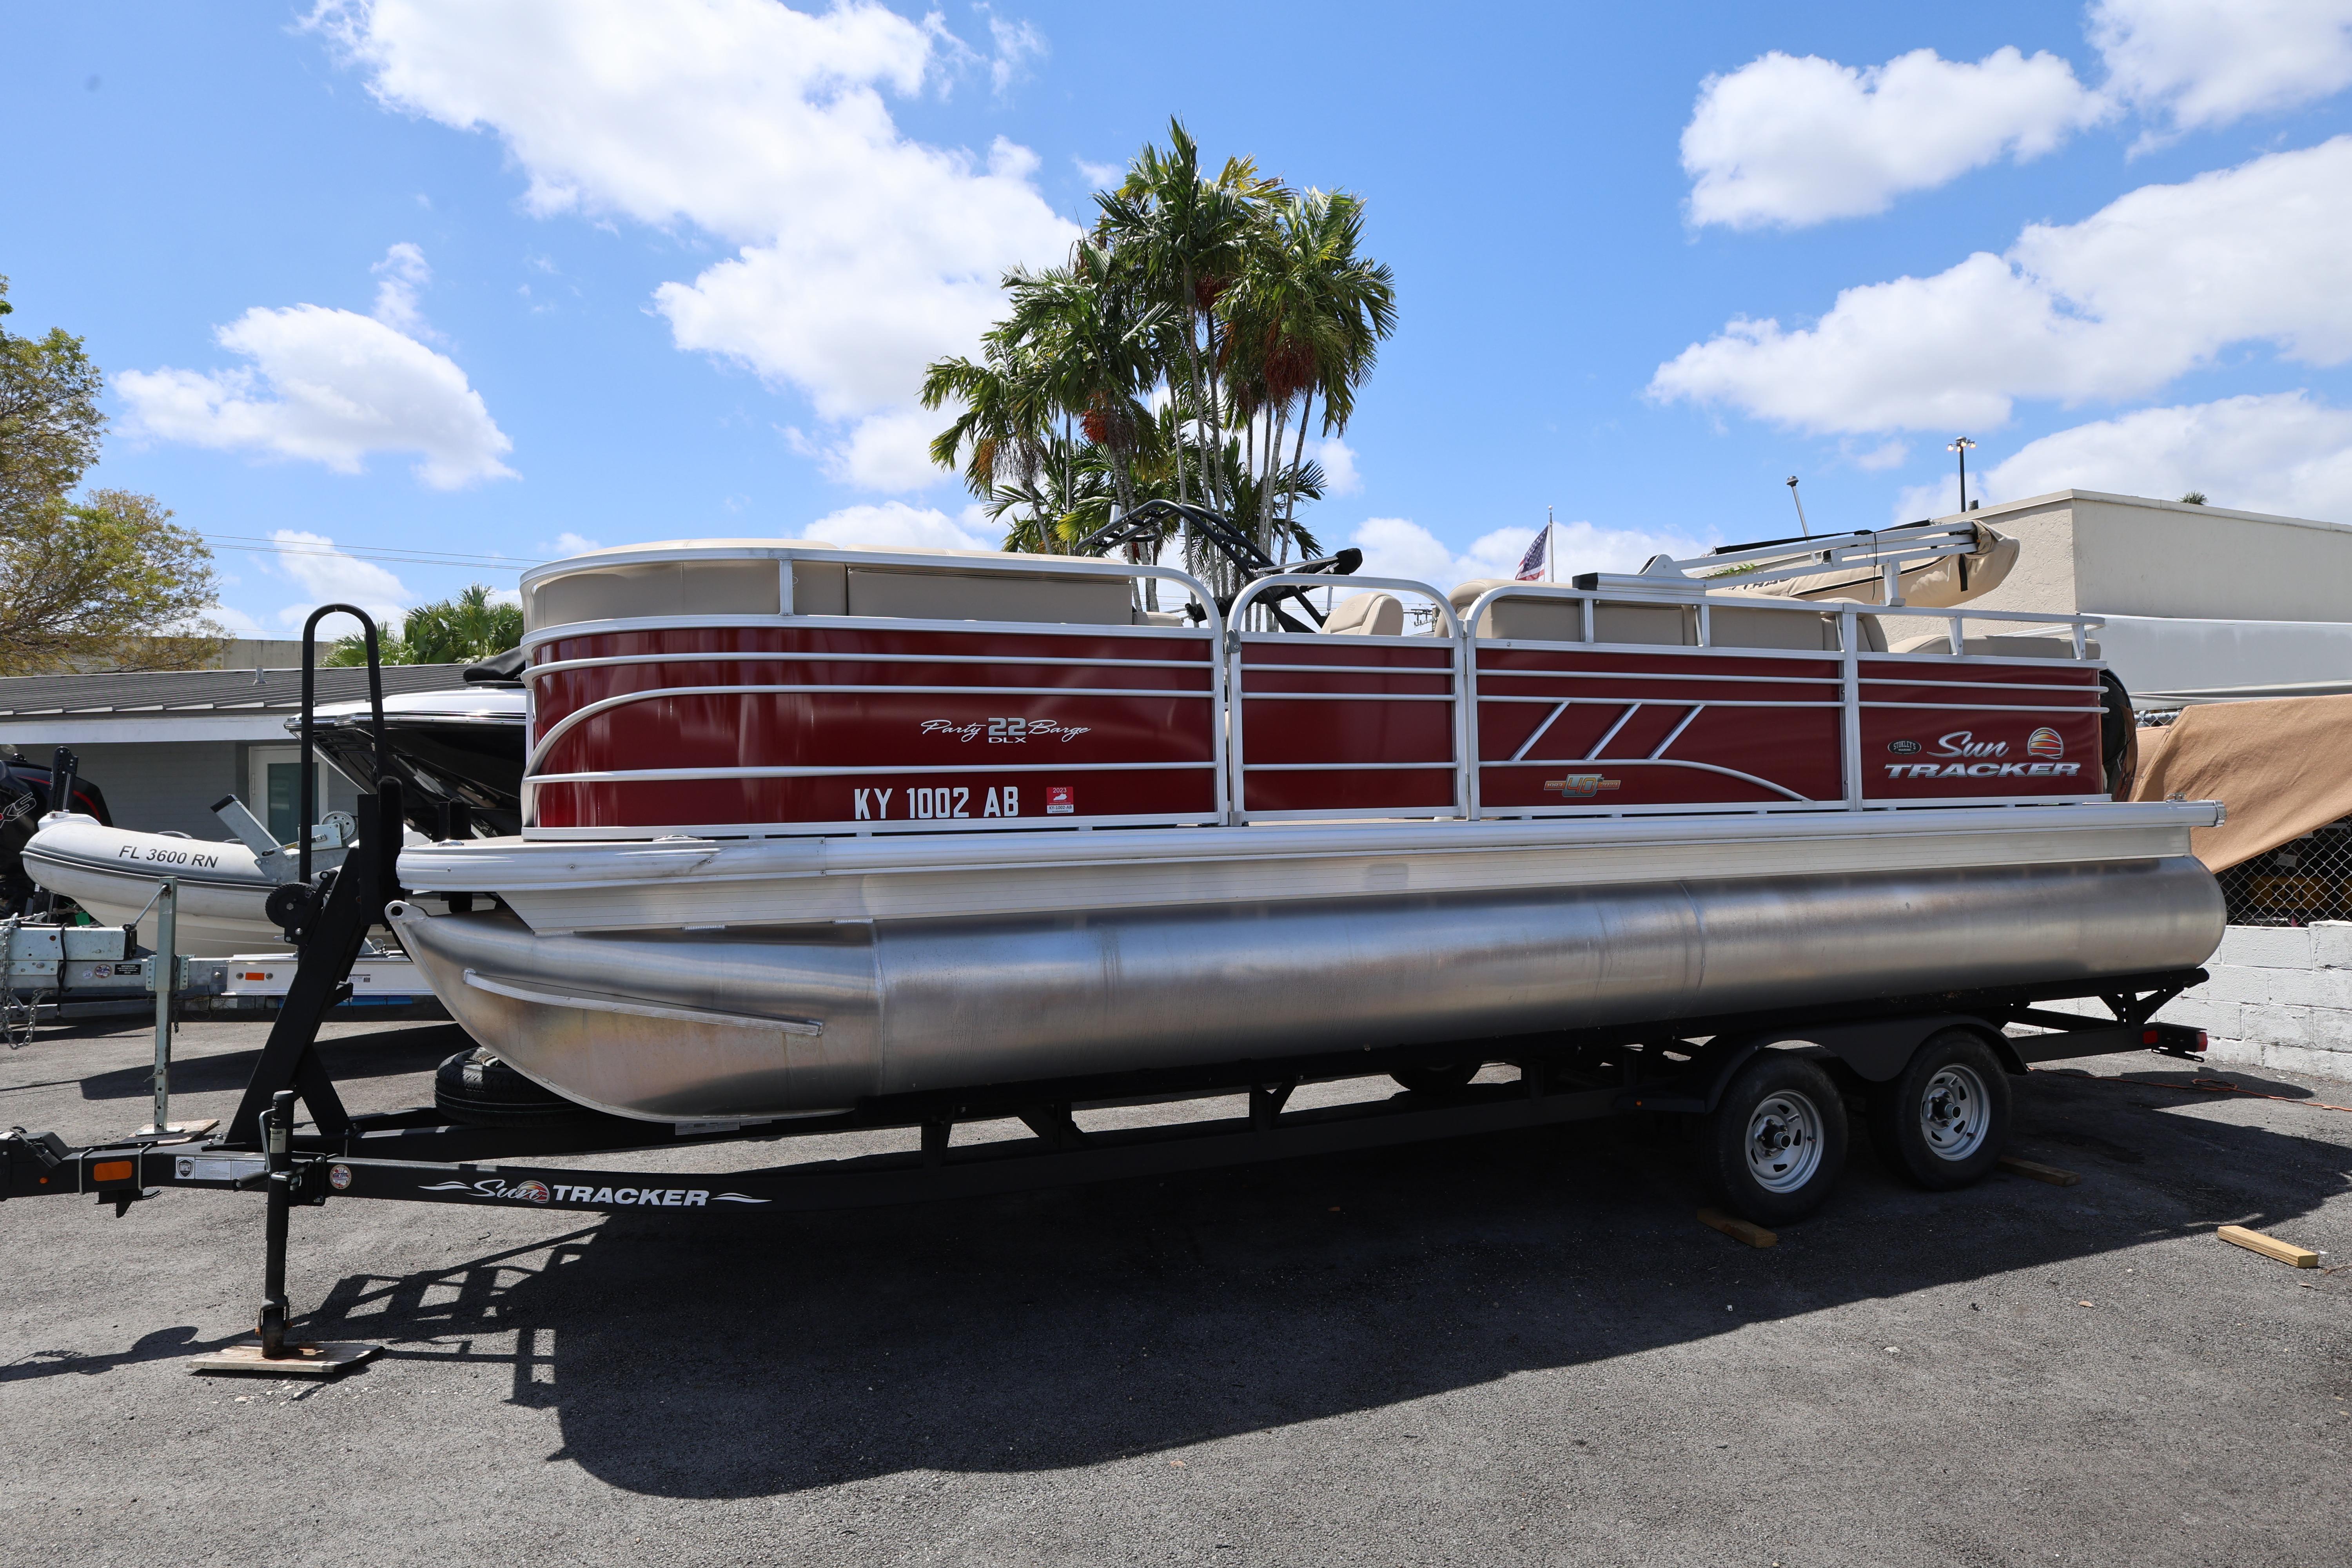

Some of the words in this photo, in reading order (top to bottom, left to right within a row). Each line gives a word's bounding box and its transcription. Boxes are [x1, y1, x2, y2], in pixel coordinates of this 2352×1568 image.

[920, 719, 986, 742] Party
[988, 717, 1026, 736] 22
[1027, 719, 1091, 742] Barge
[1893, 740, 1916, 750] STOKLEY'S
[1926, 730, 2010, 758] Sun
[1884, 762, 2081, 778] TRACKER
[855, 788, 893, 820] KY
[907, 787, 969, 818] 1002
[984, 786, 1018, 817] AB
[119, 845, 140, 859] FL
[146, 849, 187, 864] 3600
[191, 854, 218, 868] RN
[465, 1179, 543, 1201] Sun
[552, 1185, 710, 1207] TRACKER
